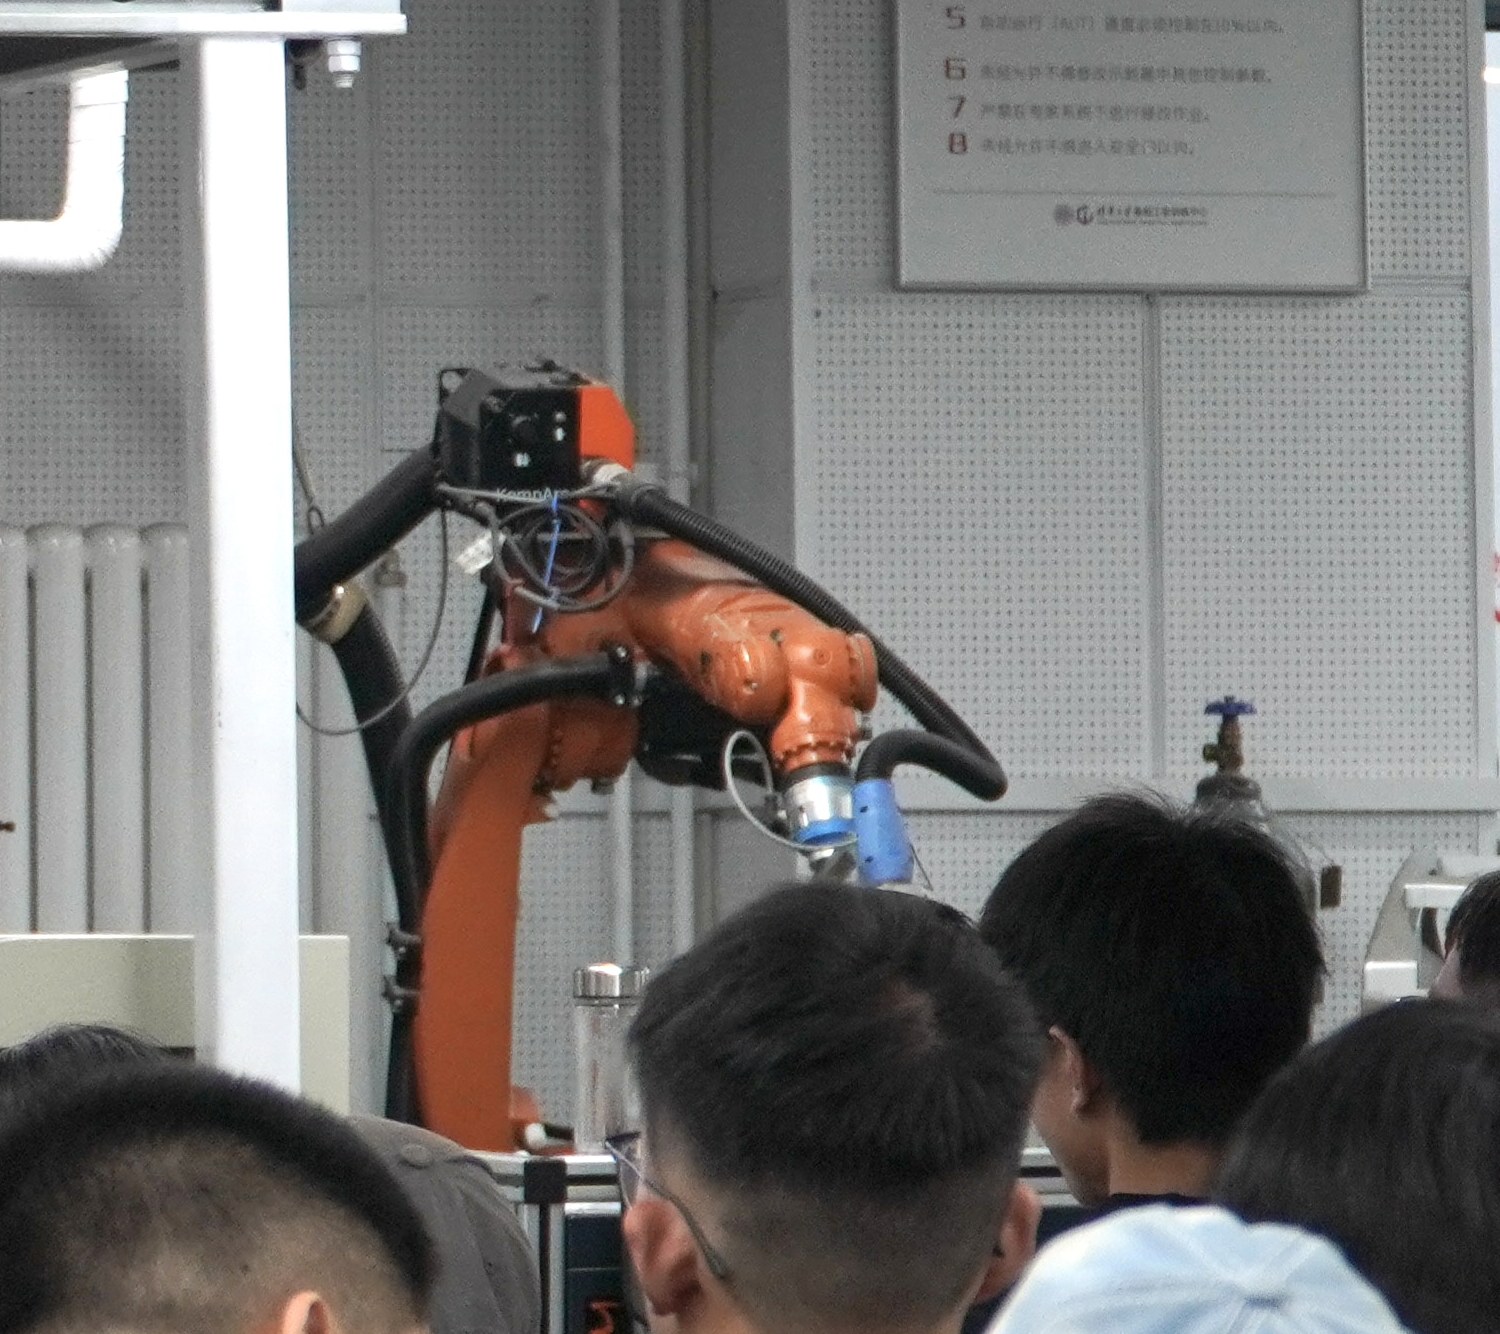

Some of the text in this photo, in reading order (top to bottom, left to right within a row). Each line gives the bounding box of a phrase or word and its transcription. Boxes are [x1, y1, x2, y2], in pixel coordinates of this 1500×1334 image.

[945, 5, 967, 31] 5
[944, 57, 967, 81] 6
[948, 95, 966, 120] 7
[947, 131, 969, 156] 8
